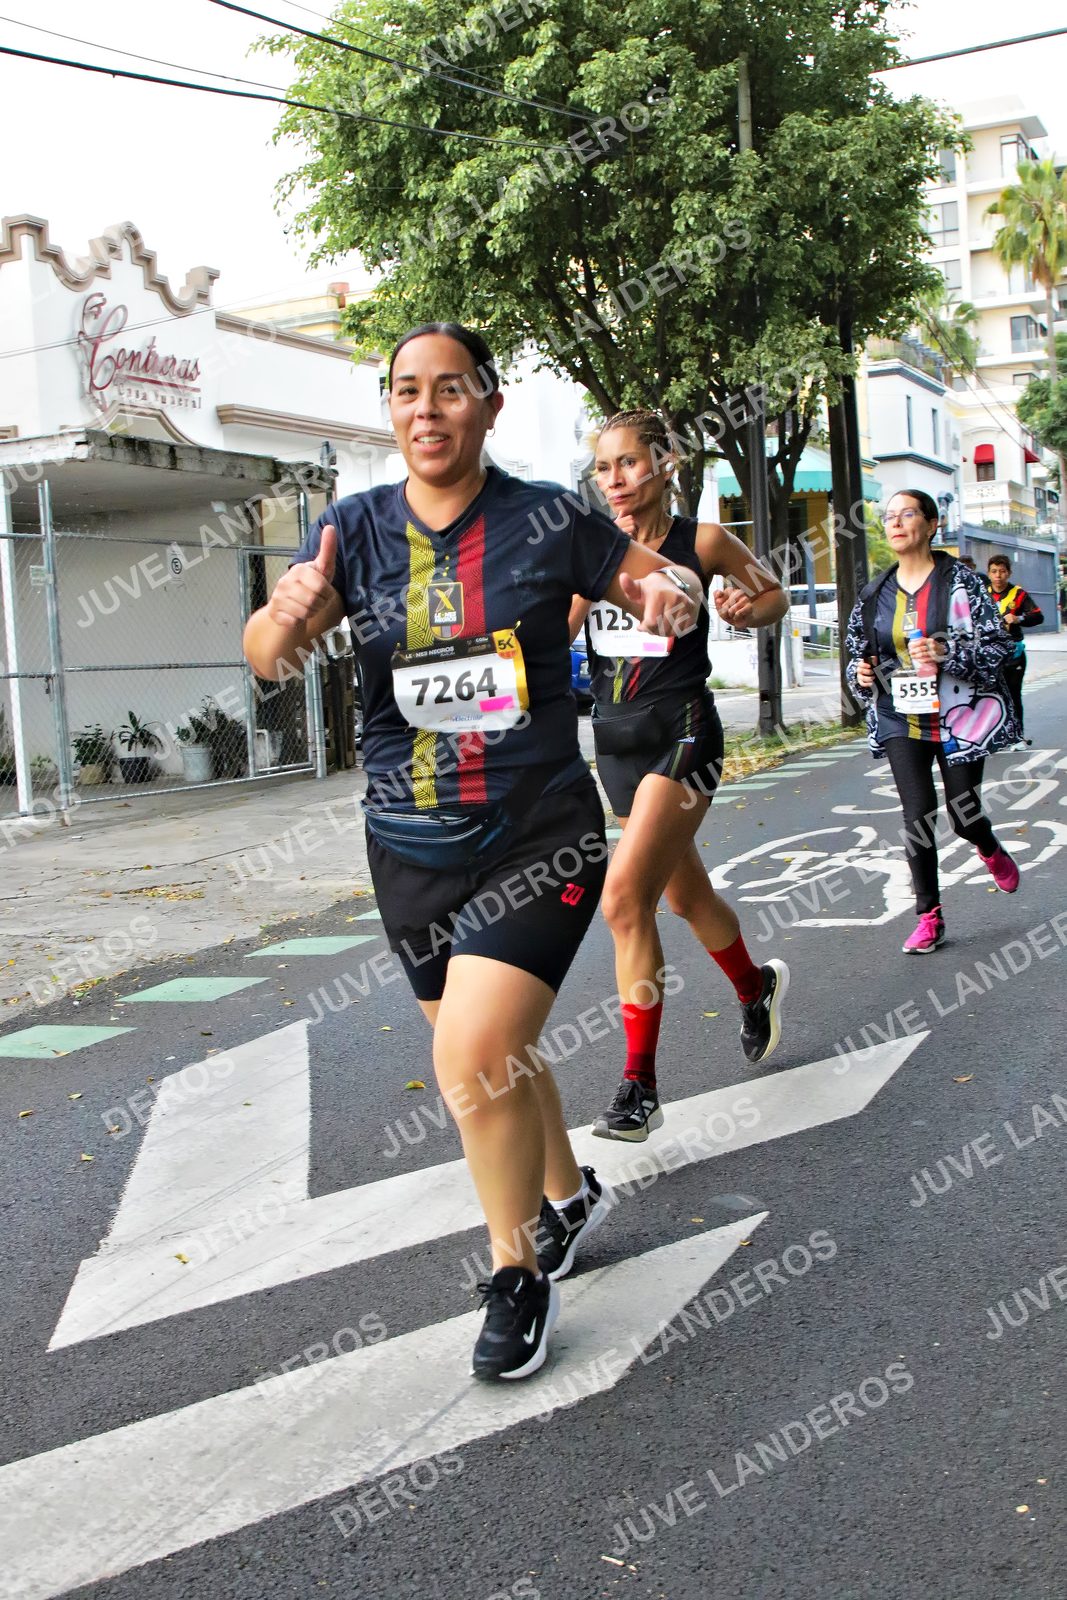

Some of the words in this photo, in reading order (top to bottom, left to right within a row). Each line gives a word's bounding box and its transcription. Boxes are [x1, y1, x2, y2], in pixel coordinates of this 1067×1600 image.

[498, 638, 514, 650] 5K
[405, 651, 428, 659] LENES
[411, 667, 497, 706] 7264
[900, 681, 938, 698] 5555
